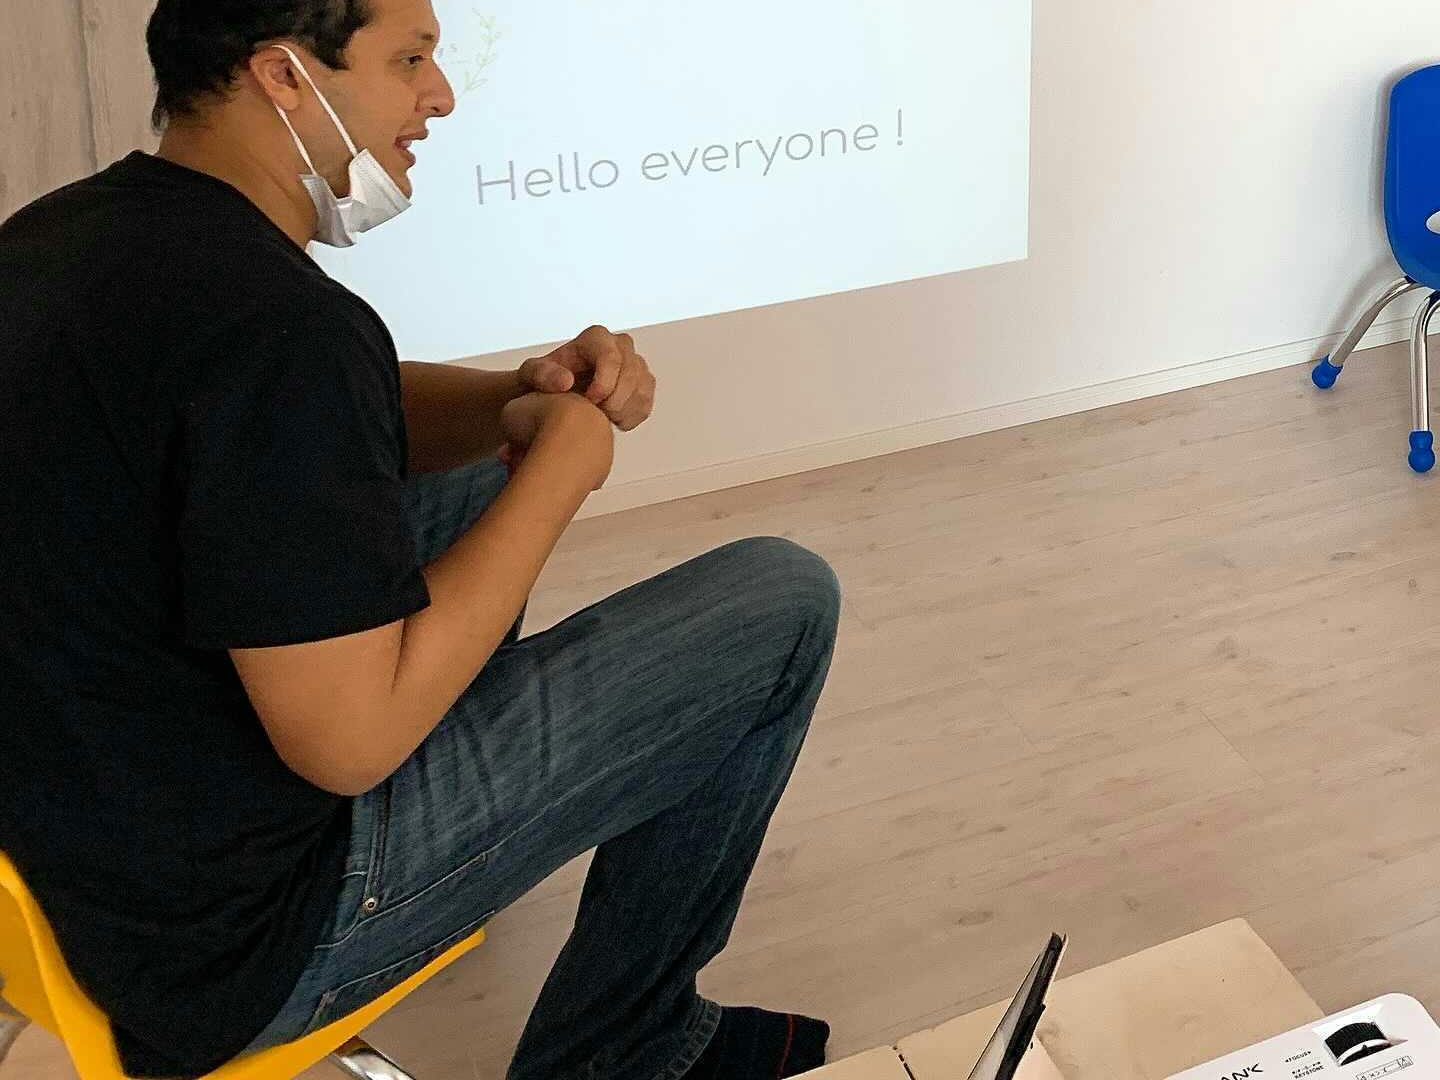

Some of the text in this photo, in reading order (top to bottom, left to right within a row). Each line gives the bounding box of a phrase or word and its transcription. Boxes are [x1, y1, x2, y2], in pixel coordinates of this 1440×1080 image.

[475, 108, 905, 206] Hello everyone !
